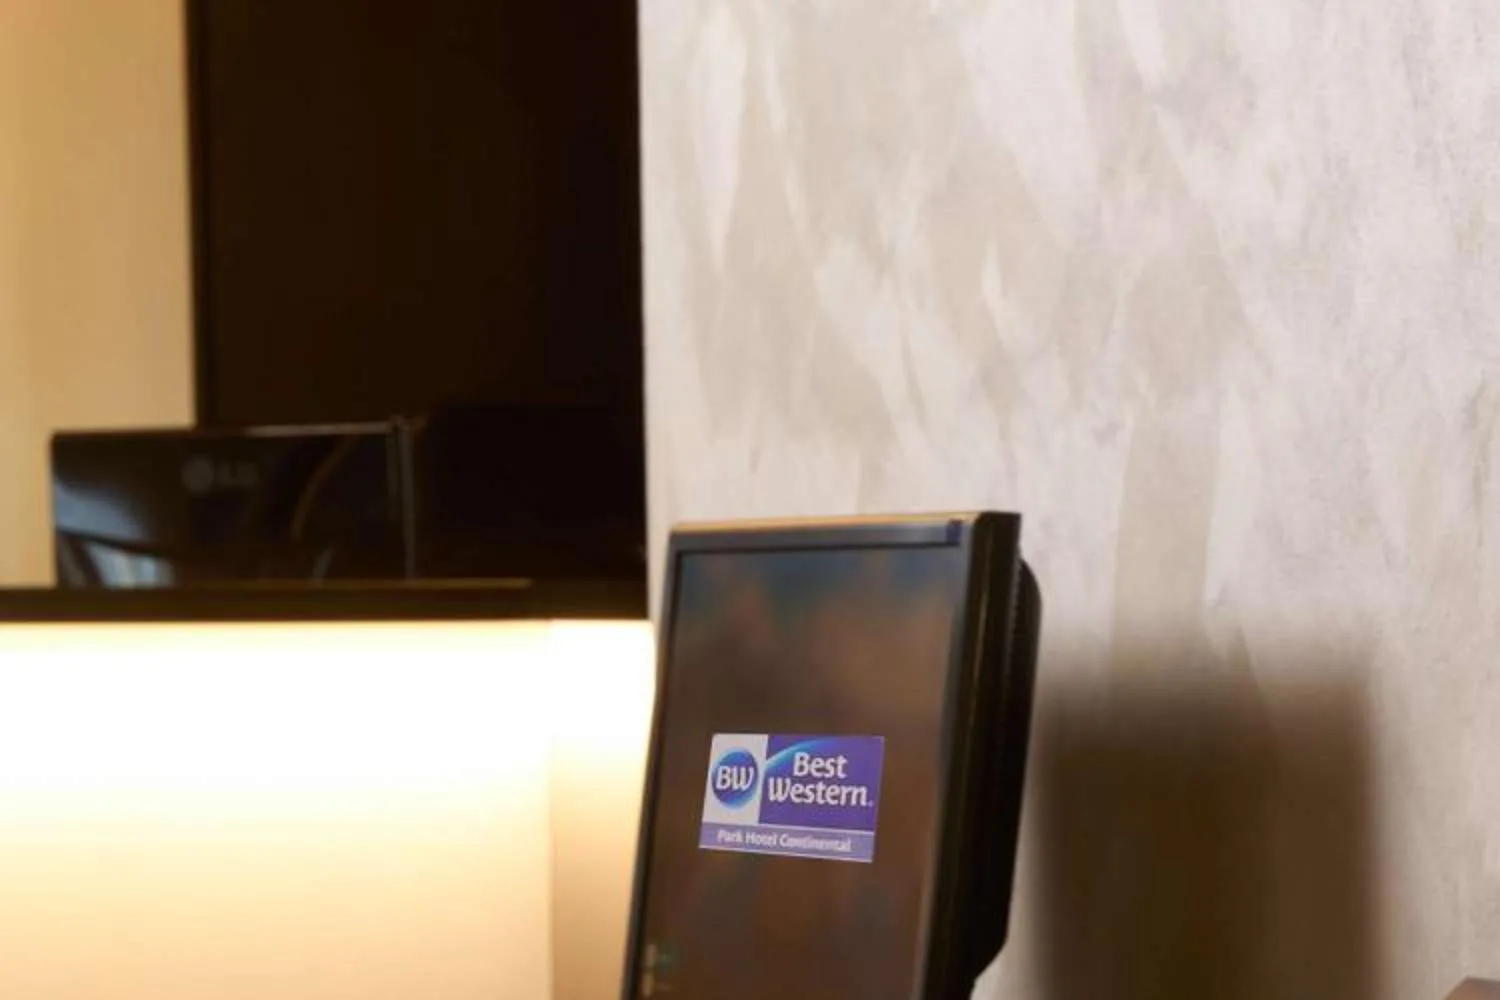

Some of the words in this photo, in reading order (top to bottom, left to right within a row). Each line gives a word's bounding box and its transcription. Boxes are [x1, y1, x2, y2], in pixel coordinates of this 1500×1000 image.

[793, 752, 848, 779] Best
[716, 766, 754, 791] BW
[717, 829, 743, 844] Park
[745, 833, 777, 848] Hotel
[779, 834, 851, 852] Continental
